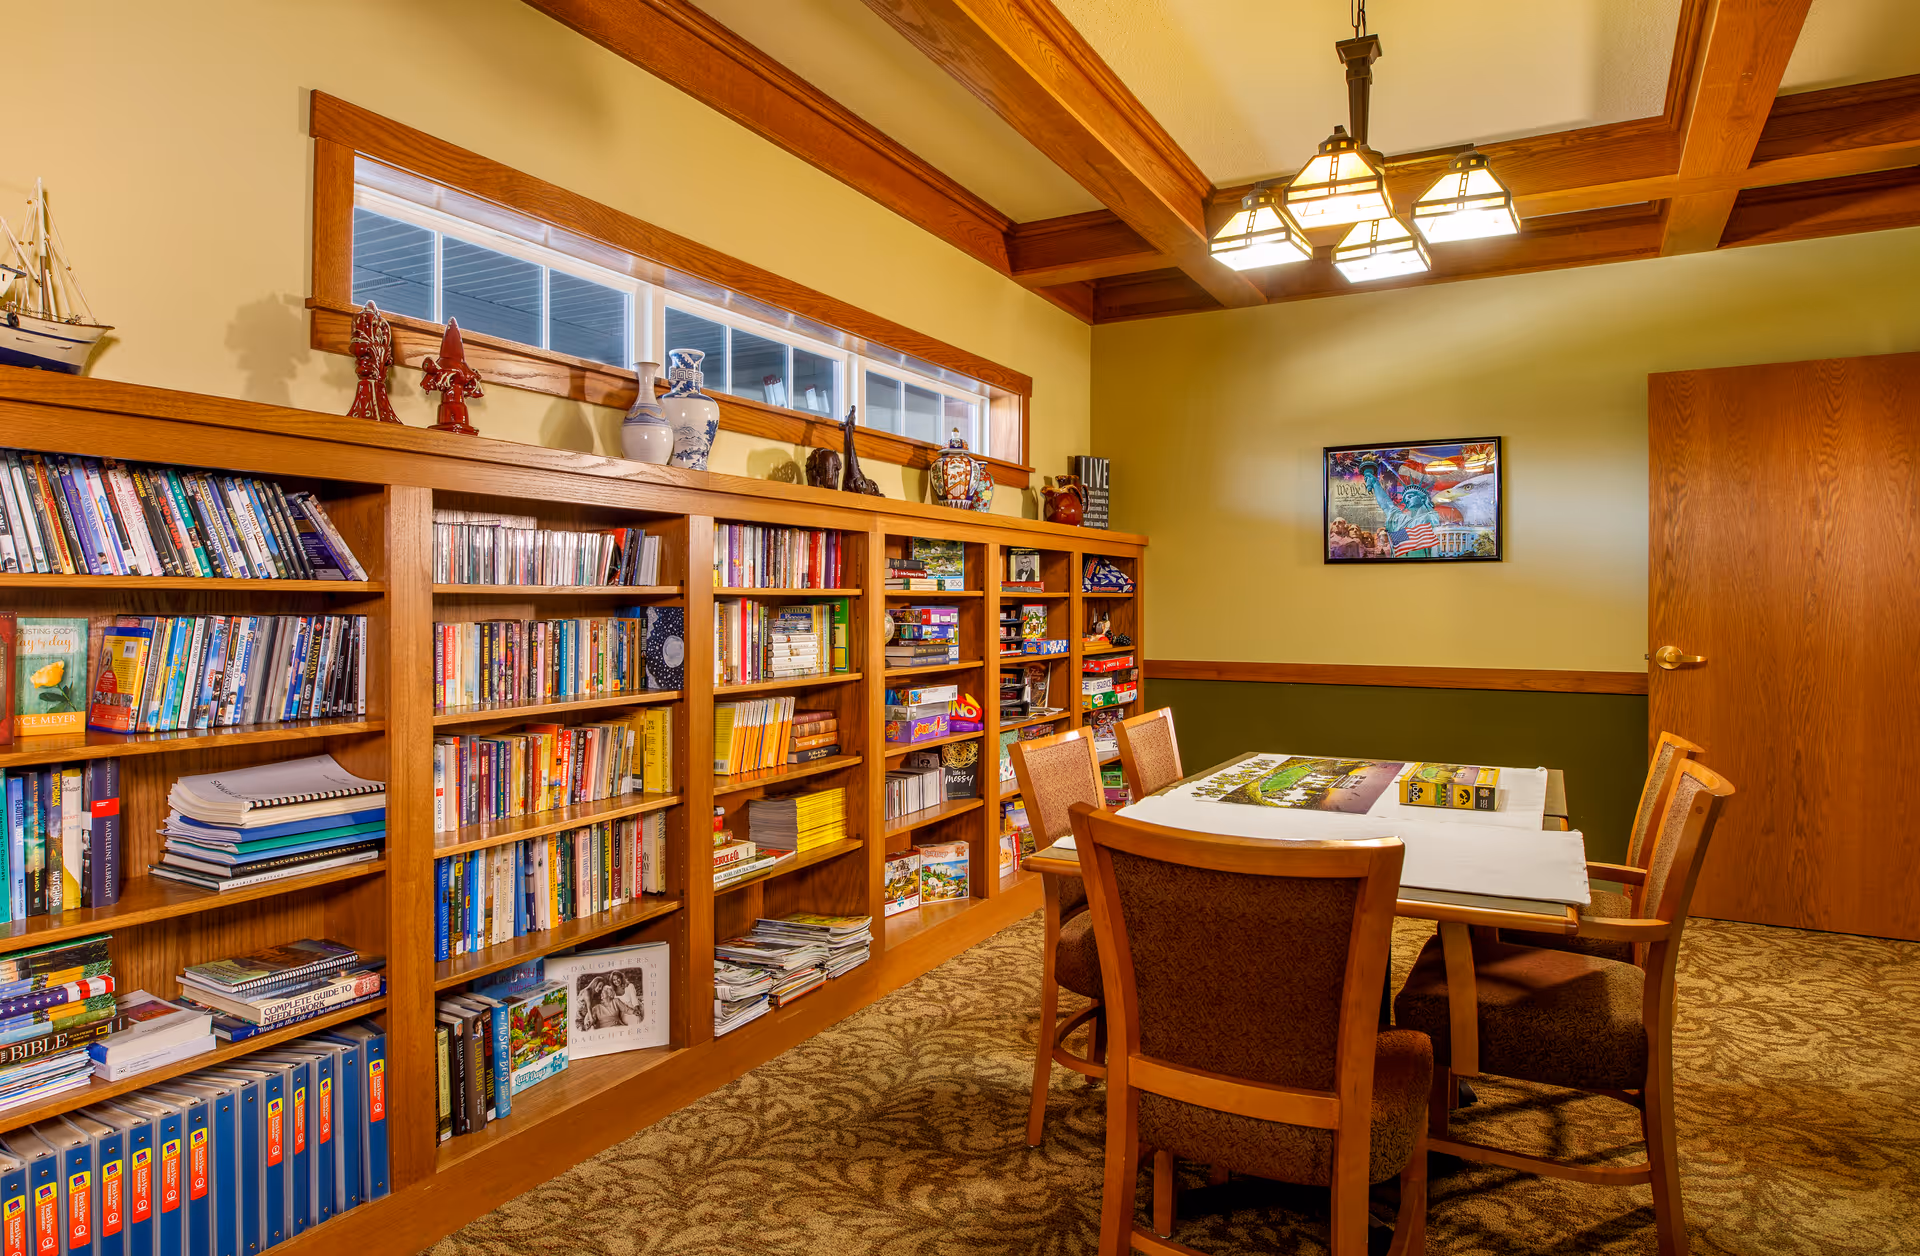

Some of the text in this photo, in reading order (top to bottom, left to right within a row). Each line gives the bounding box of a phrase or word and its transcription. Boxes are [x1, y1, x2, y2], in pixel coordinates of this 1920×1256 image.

[1082, 457, 1109, 489] LIVE
[83, 494, 98, 530] RAIN MAN
[127, 490, 144, 524] DORIS DAY
[167, 491, 181, 520] VACATION
[172, 481, 189, 518] DVD SERIES
[159, 496, 183, 550] 3:10 YUMA
[239, 514, 253, 541] FAMILY
[207, 526, 222, 554] LEGENDS
[48, 635, 72, 653] day
[236, 634, 246, 661] MARTIAN
[309, 636, 321, 679] TV WESTERNS
[14, 715, 76, 726] YCE MEYER
[52, 773, 61, 807] SWITCHBACK
[945, 775, 974, 786] messy
[15, 799, 23, 828] BEAUTIFUL
[742, 864, 757, 873] TRACTORS
[52, 870, 61, 907] HUTCHINS
[570, 957, 650, 973] DAUGHTERS
[264, 984, 352, 1017] COMPLETE GUIDE TO
[650, 963, 658, 1025] MOTHERS
[248, 1028, 256, 1037] A
[325, 1003, 341, 1013] Lutheran
[264, 1000, 326, 1024] NEEDLEWORK
[9, 1033, 69, 1061] BIBLE
[498, 1022, 509, 1050] MUSIC
[571, 1026, 649, 1045] DAUGHTERS
[474, 1041, 484, 1092] LAURA BUSH
[499, 1060, 510, 1082] BEES
[515, 1067, 548, 1086] Lazy Days
[486, 1068, 494, 1100] PRIVATE
